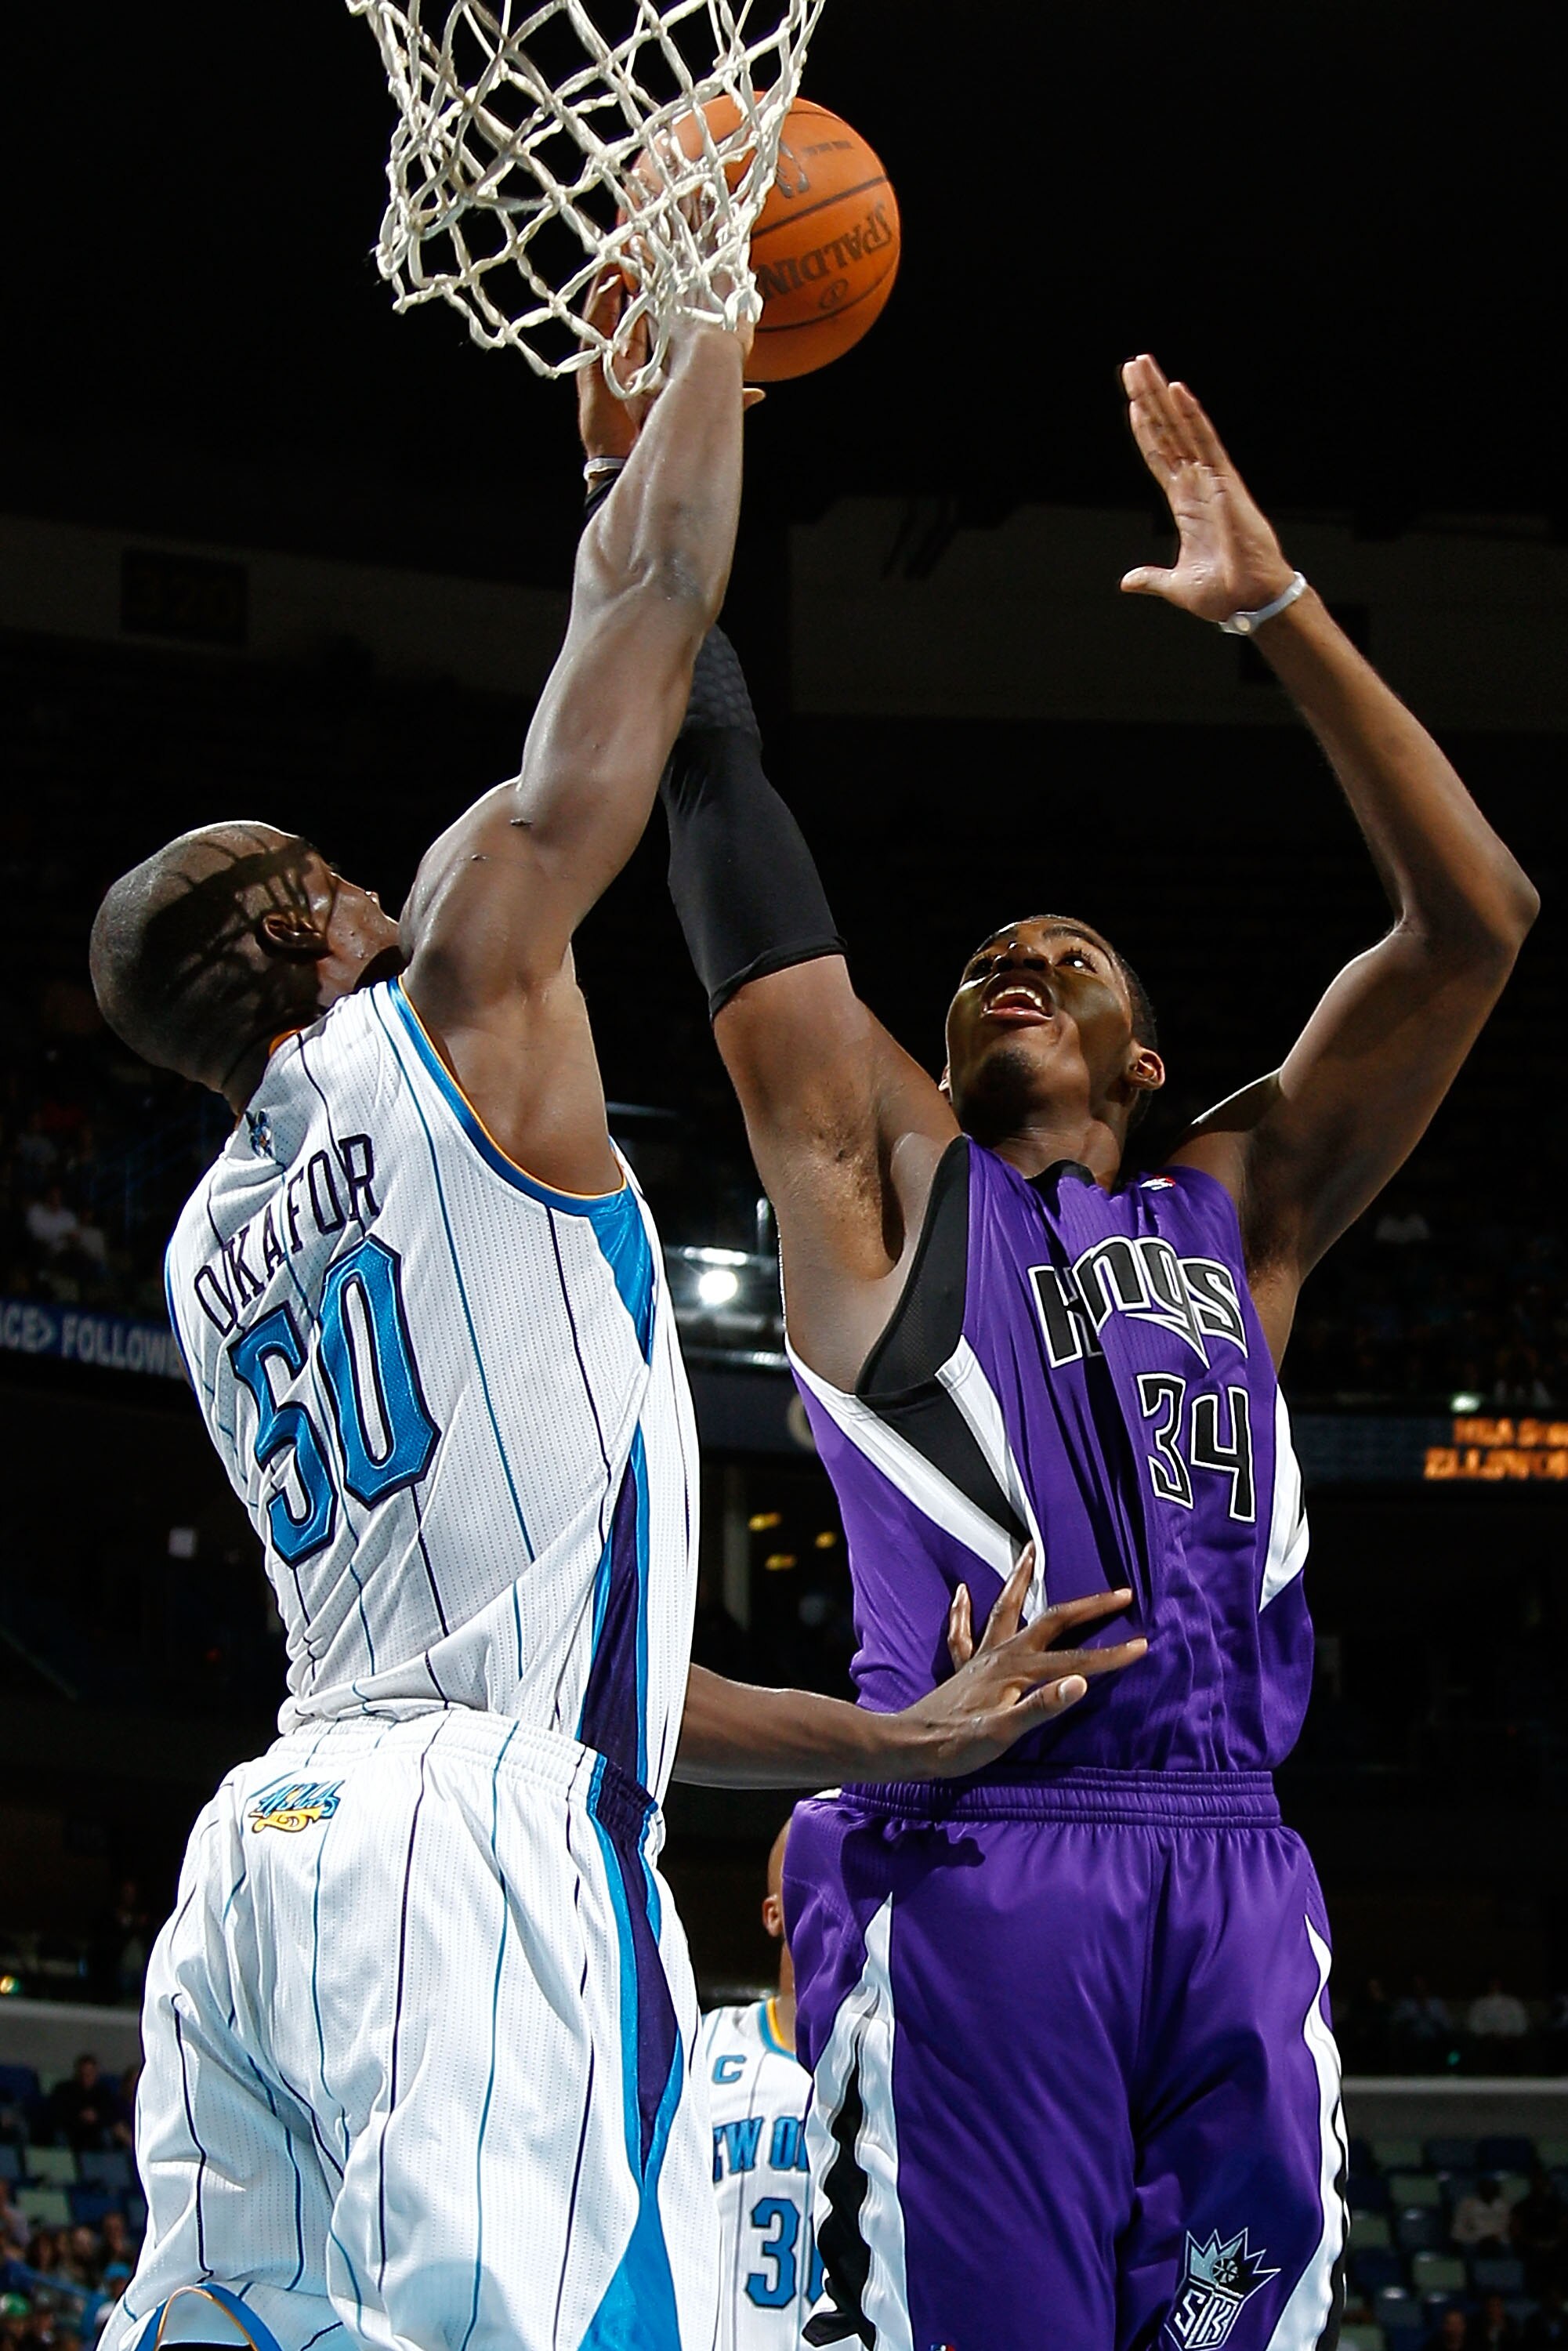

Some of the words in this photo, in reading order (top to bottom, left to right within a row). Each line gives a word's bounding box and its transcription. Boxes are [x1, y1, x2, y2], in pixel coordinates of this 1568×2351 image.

[755, 201, 893, 301] SPALDIN
[194, 1133, 381, 1335] OKAFOR
[1027, 1235, 1249, 1370] KNGS
[226, 1233, 442, 1569] 50
[1136, 1372, 1256, 1523] 34
[711, 2054, 748, 2085] C
